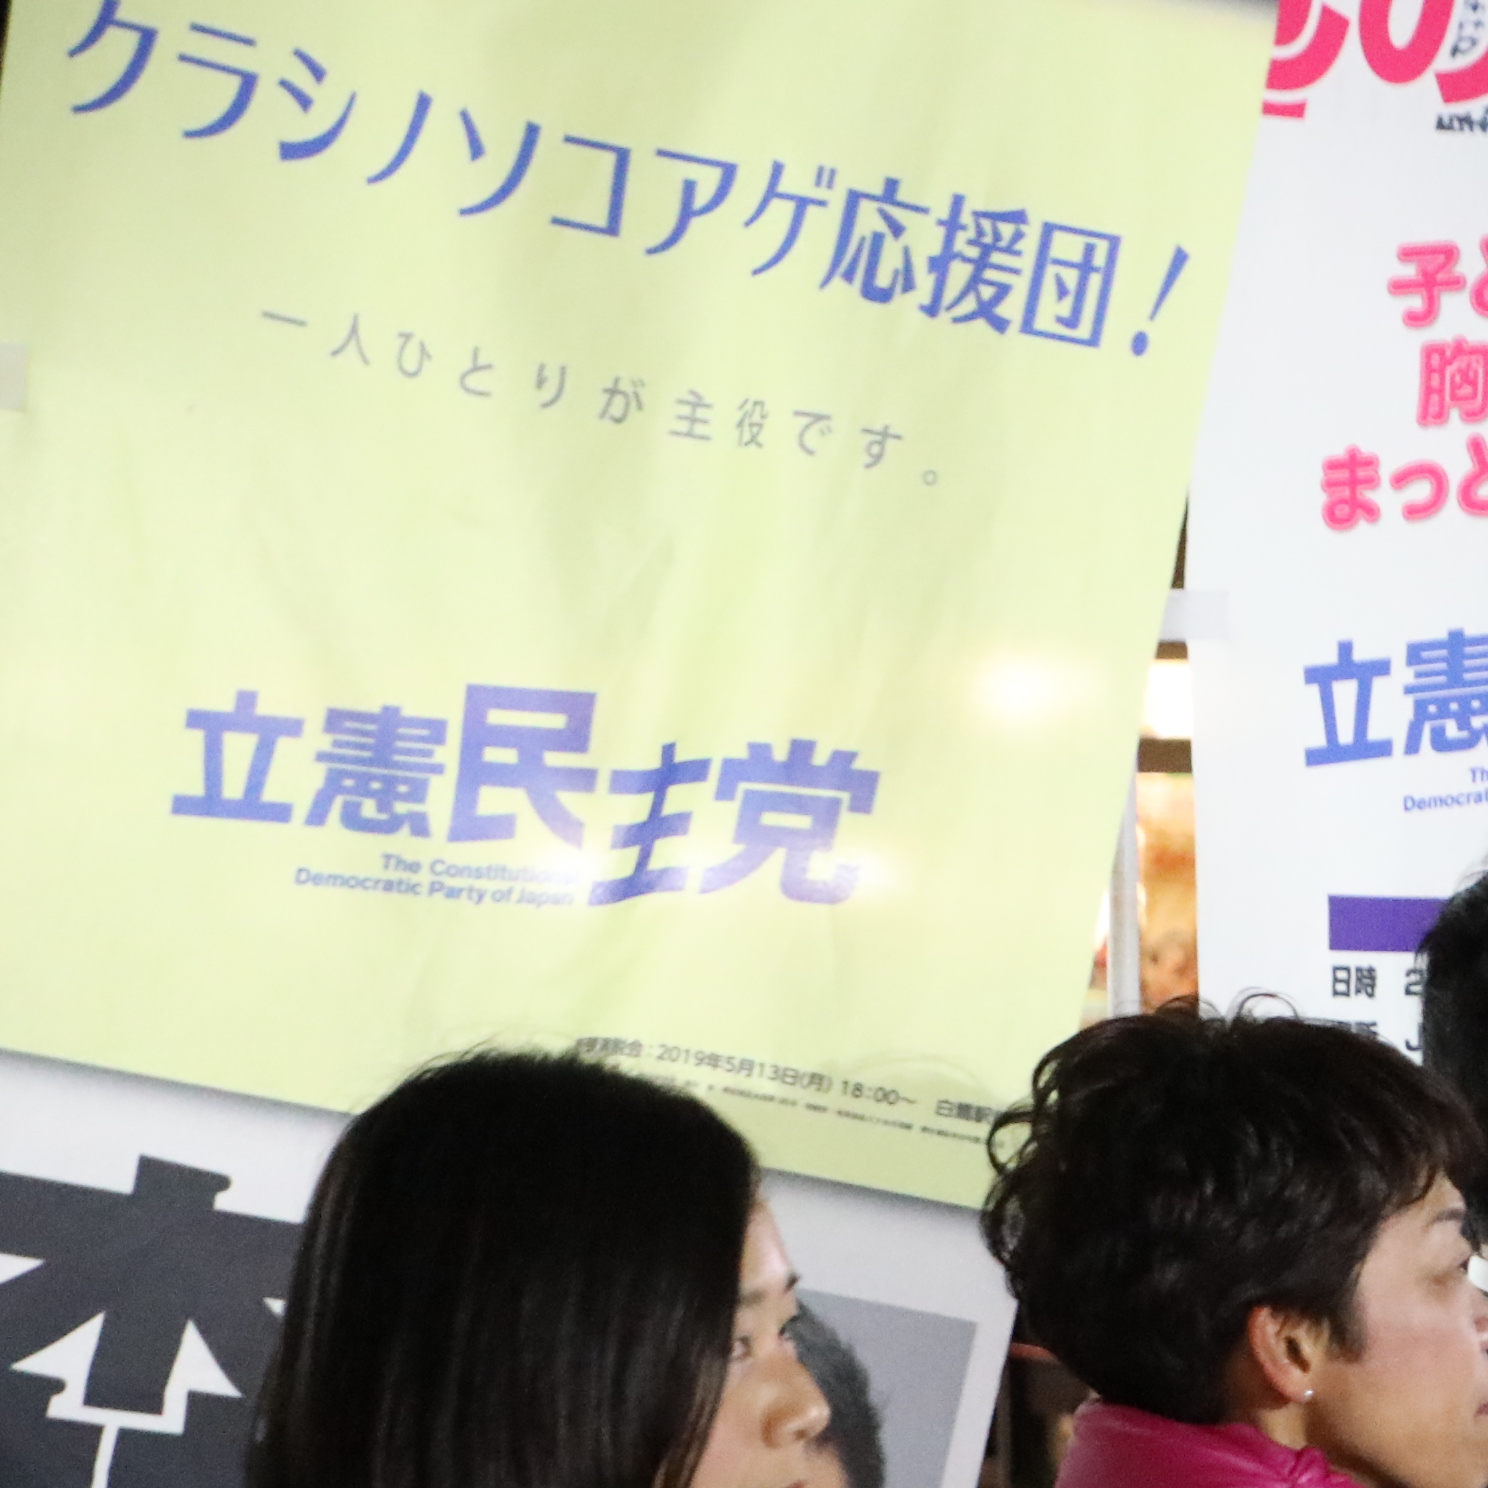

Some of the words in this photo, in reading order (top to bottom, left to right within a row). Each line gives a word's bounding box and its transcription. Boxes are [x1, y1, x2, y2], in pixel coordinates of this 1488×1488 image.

[260, 308, 940, 488] 一人ひとりが主役です。
[170, 683, 880, 906] 立憲民主党
[294, 867, 422, 897] Democratic
[427, 880, 488, 905] Party
[490, 886, 513, 904] of
[381, 853, 422, 875] The
